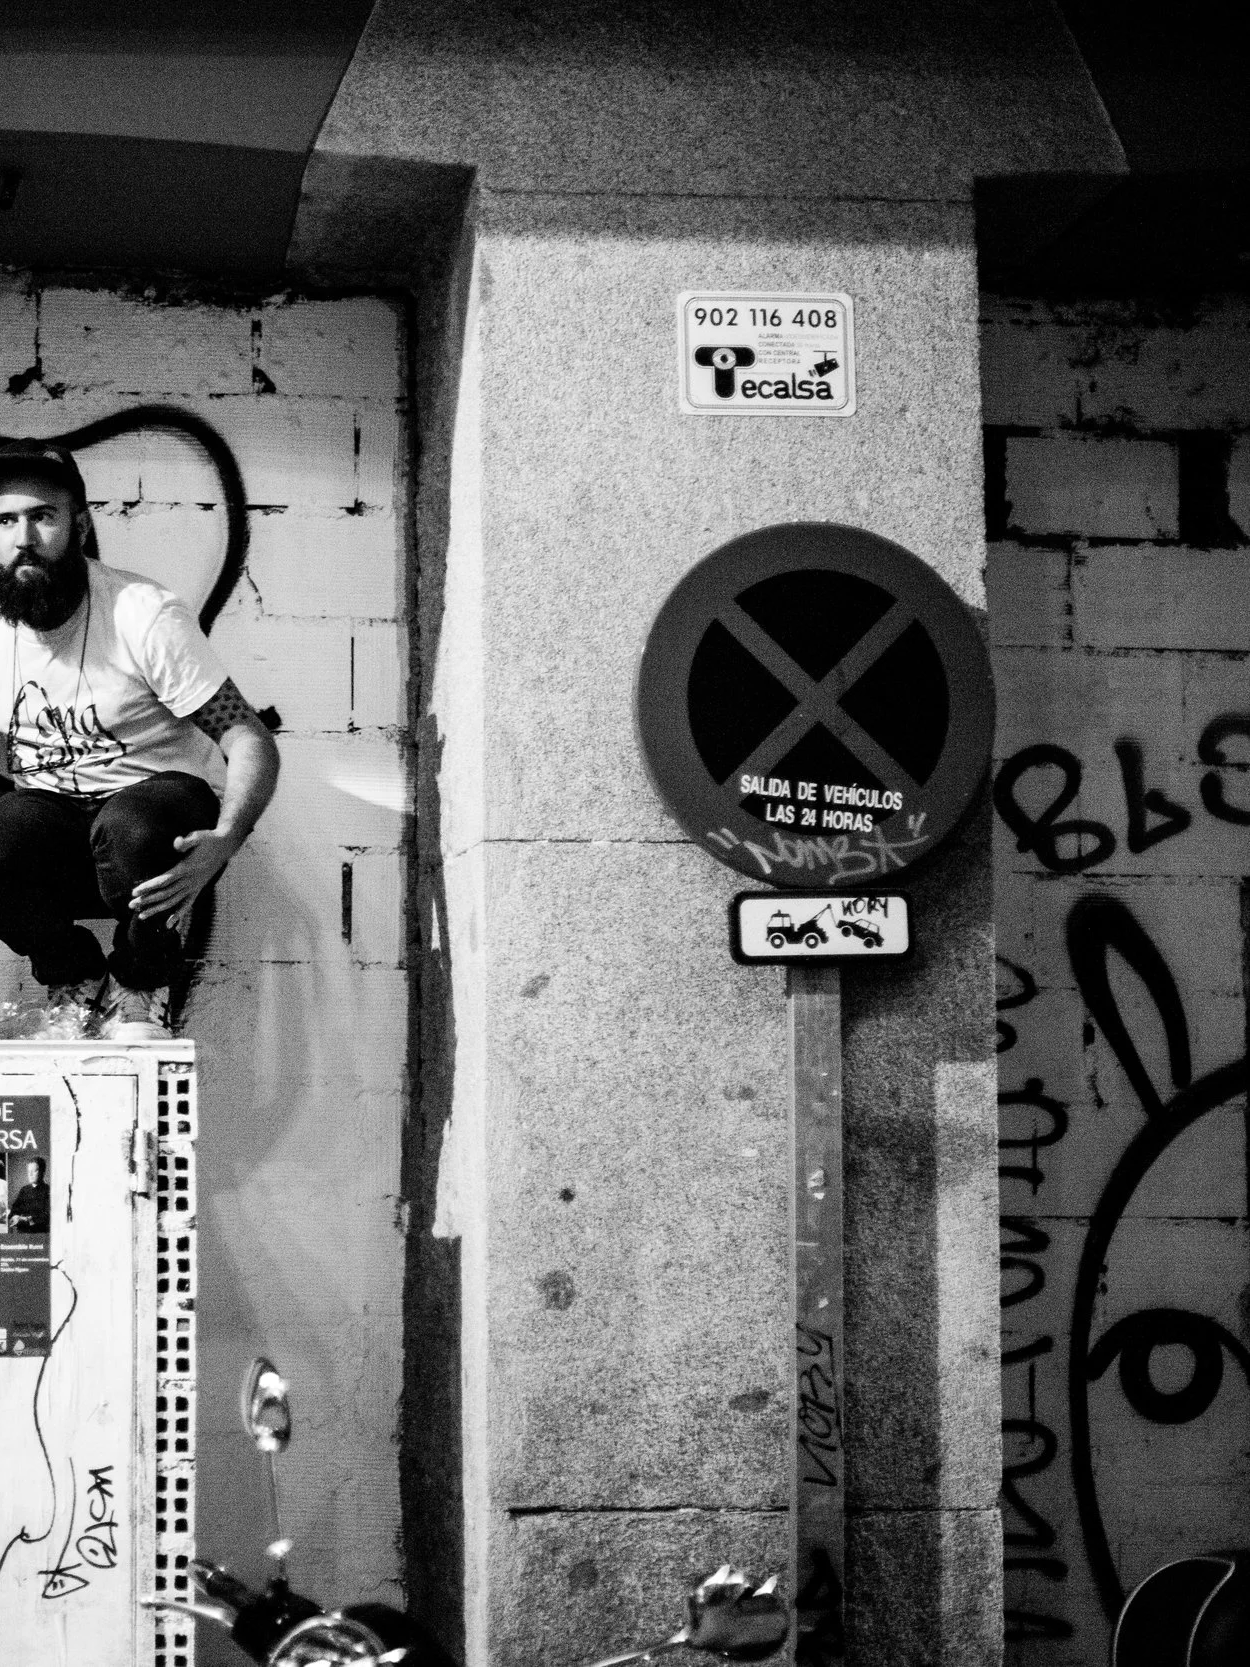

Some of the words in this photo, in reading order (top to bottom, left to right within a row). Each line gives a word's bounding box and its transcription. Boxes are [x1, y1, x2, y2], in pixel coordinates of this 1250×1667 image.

[694, 307, 739, 327] 902
[749, 308, 782, 327] 116
[792, 309, 838, 329] 408
[740, 774, 791, 799] SALIDA
[797, 781, 818, 802] DE
[824, 782, 904, 811] VEHÍCULOS
[765, 803, 796, 825] LAS
[801, 808, 817, 826] 24
[822, 810, 874, 833] HORAS
